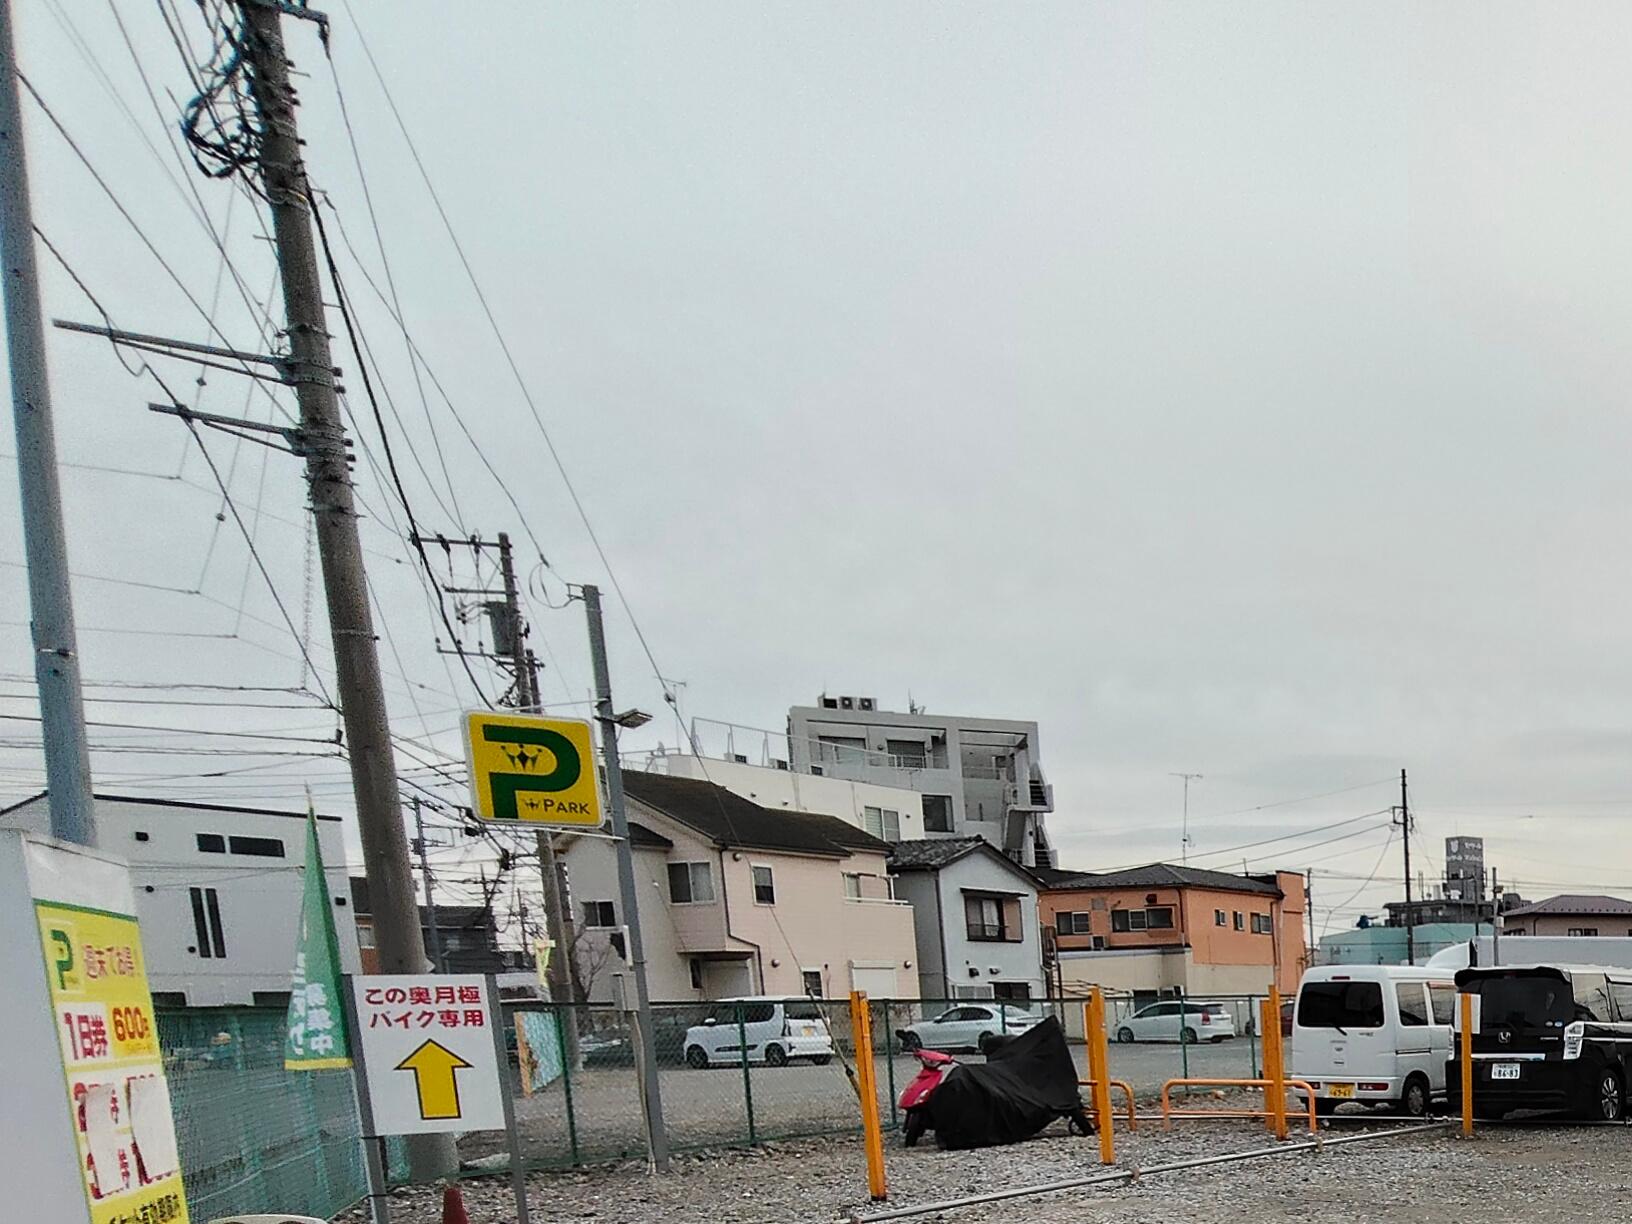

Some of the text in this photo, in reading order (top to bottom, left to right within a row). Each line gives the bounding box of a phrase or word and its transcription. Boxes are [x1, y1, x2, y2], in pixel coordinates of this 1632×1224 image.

[482, 724, 581, 819] P
[543, 799, 591, 815] PARK
[365, 986, 481, 1005] この奥月極
[370, 1009, 484, 1029] バイク専用
